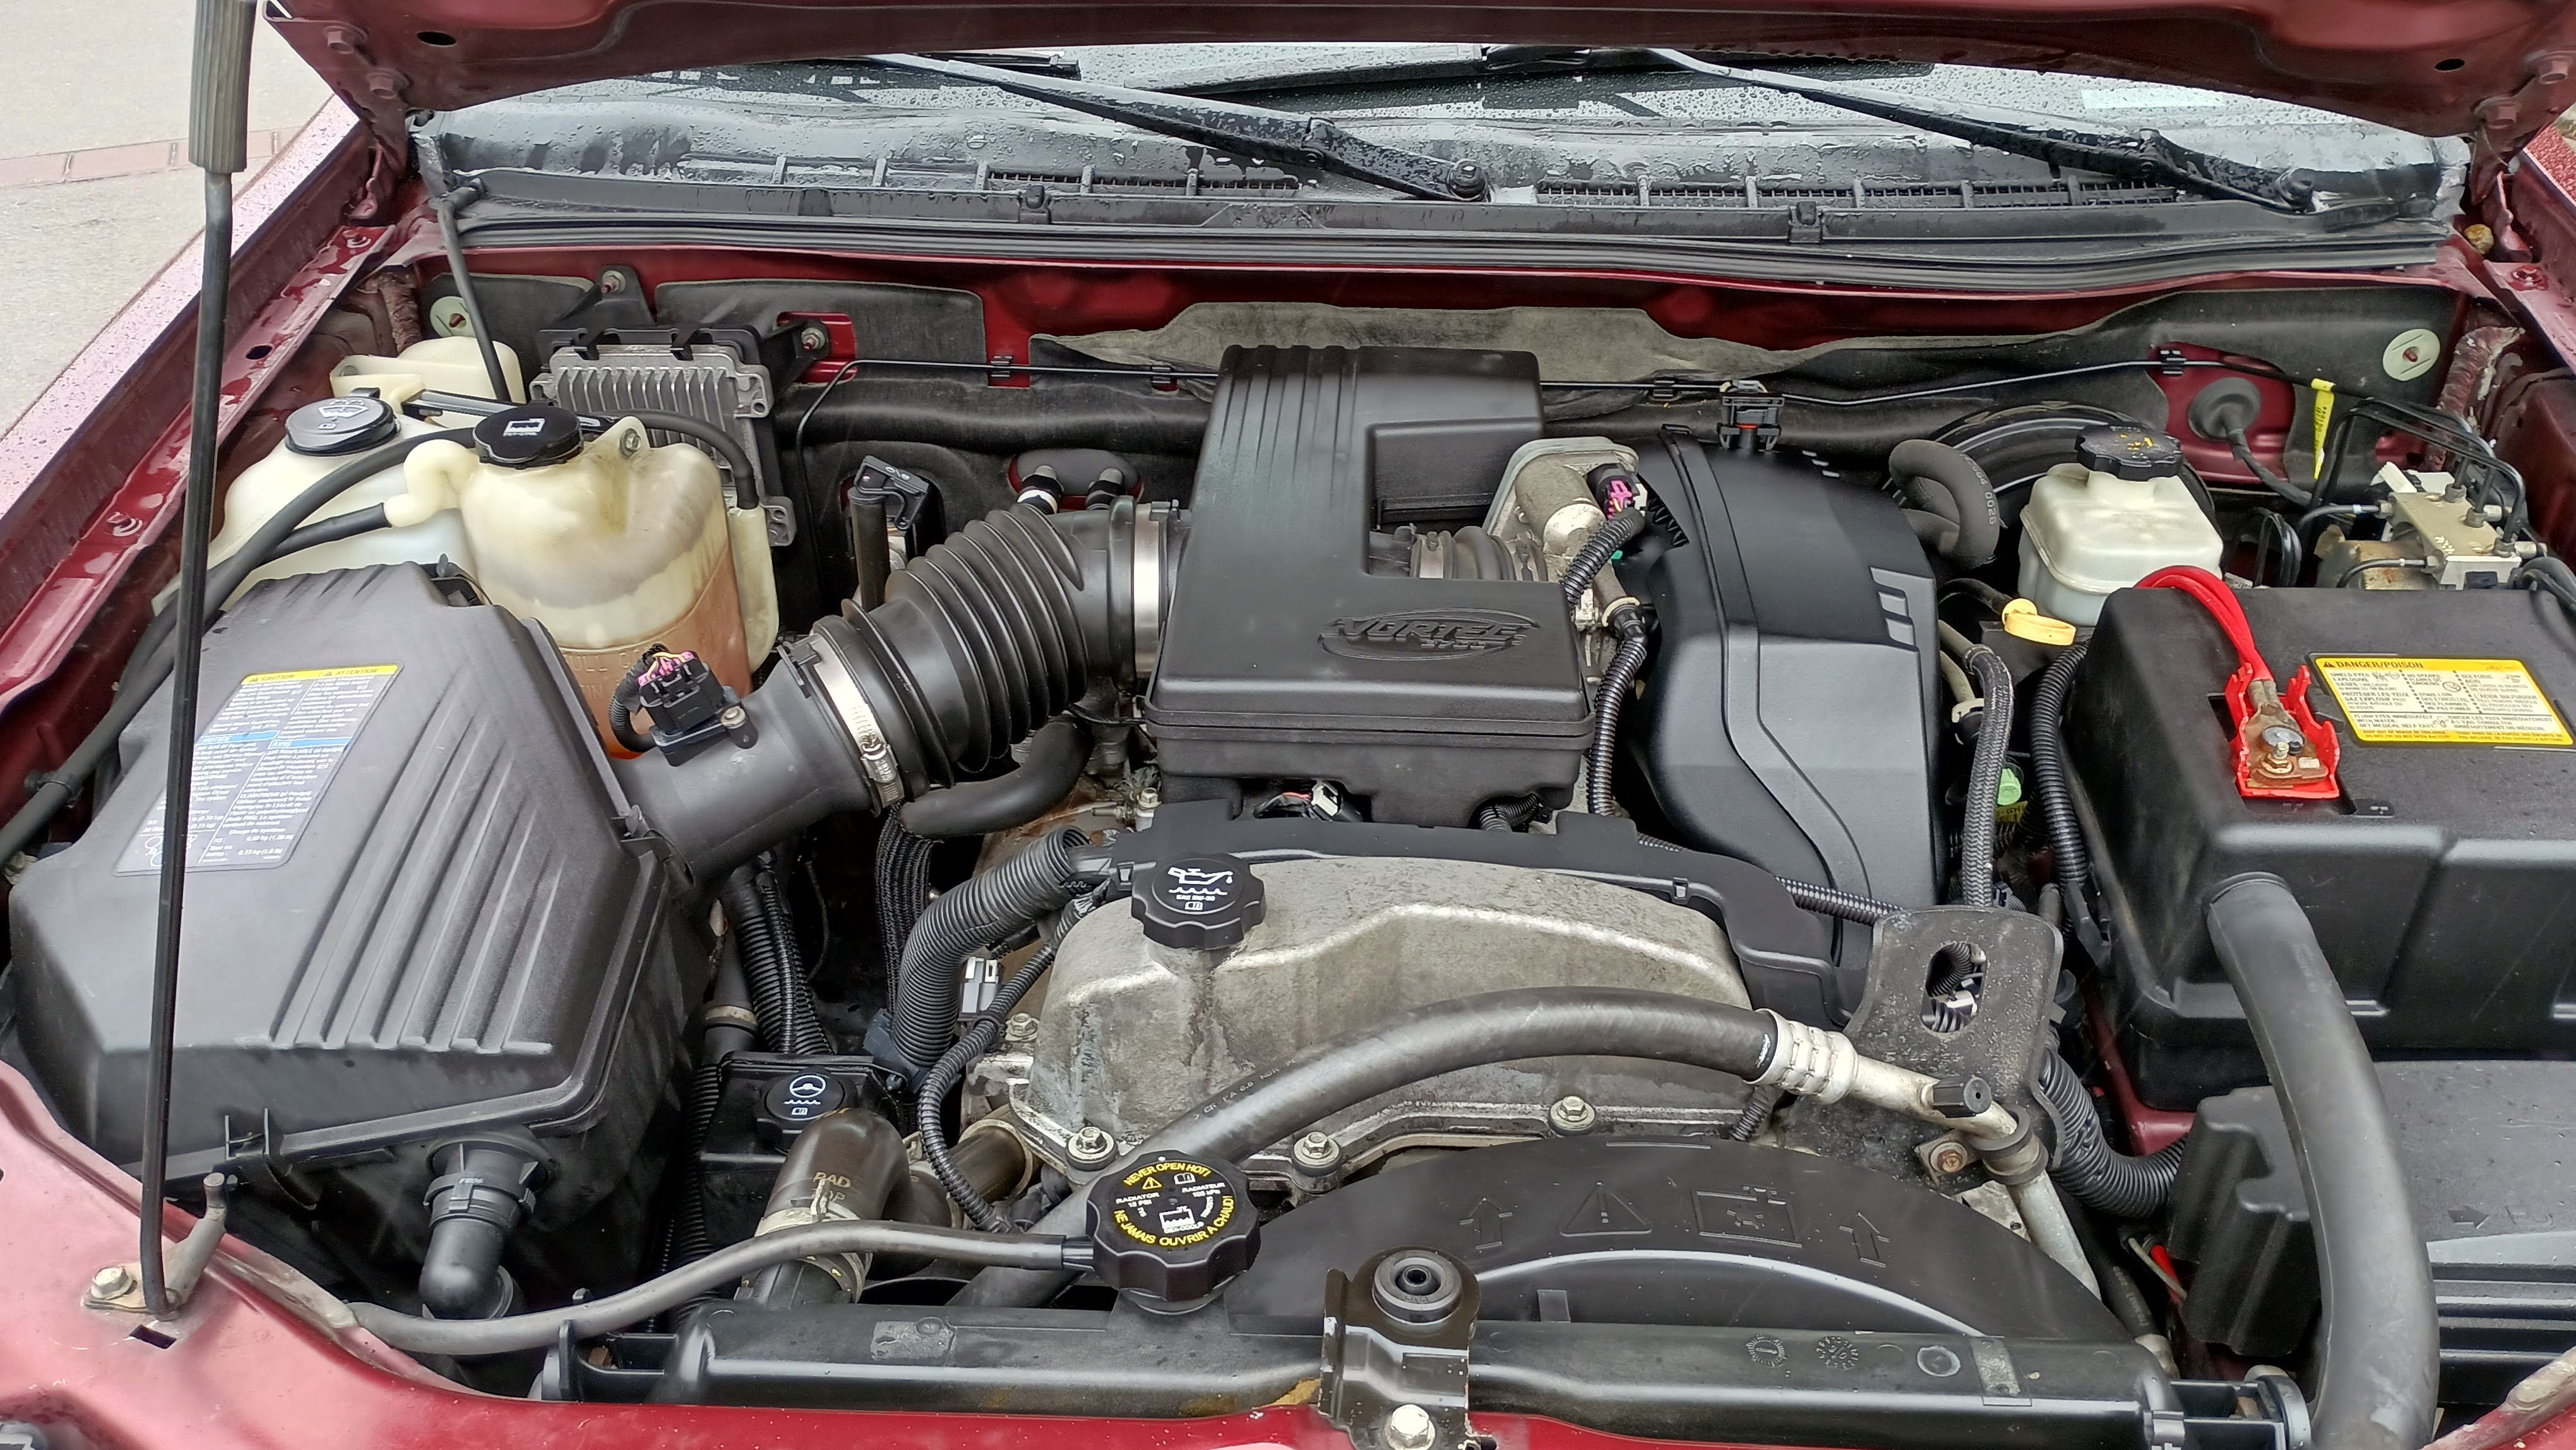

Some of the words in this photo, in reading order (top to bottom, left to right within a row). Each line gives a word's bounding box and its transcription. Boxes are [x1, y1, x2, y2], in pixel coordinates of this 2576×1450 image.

[1124, 1166, 1157, 1186] NEVER
[1156, 1163, 1186, 1171] OPEN
[1186, 1164, 1212, 1177] HOT!
[1182, 1182, 1225, 1194] RADIATEUR
[1116, 1192, 1160, 1204] RADIATOR
[1114, 1209, 1129, 1223] NE
[1213, 1195, 1234, 1228] CHAUD!
[1121, 1223, 1157, 1244] JAMAIS
[1159, 1231, 1209, 1246] OUVRIR
